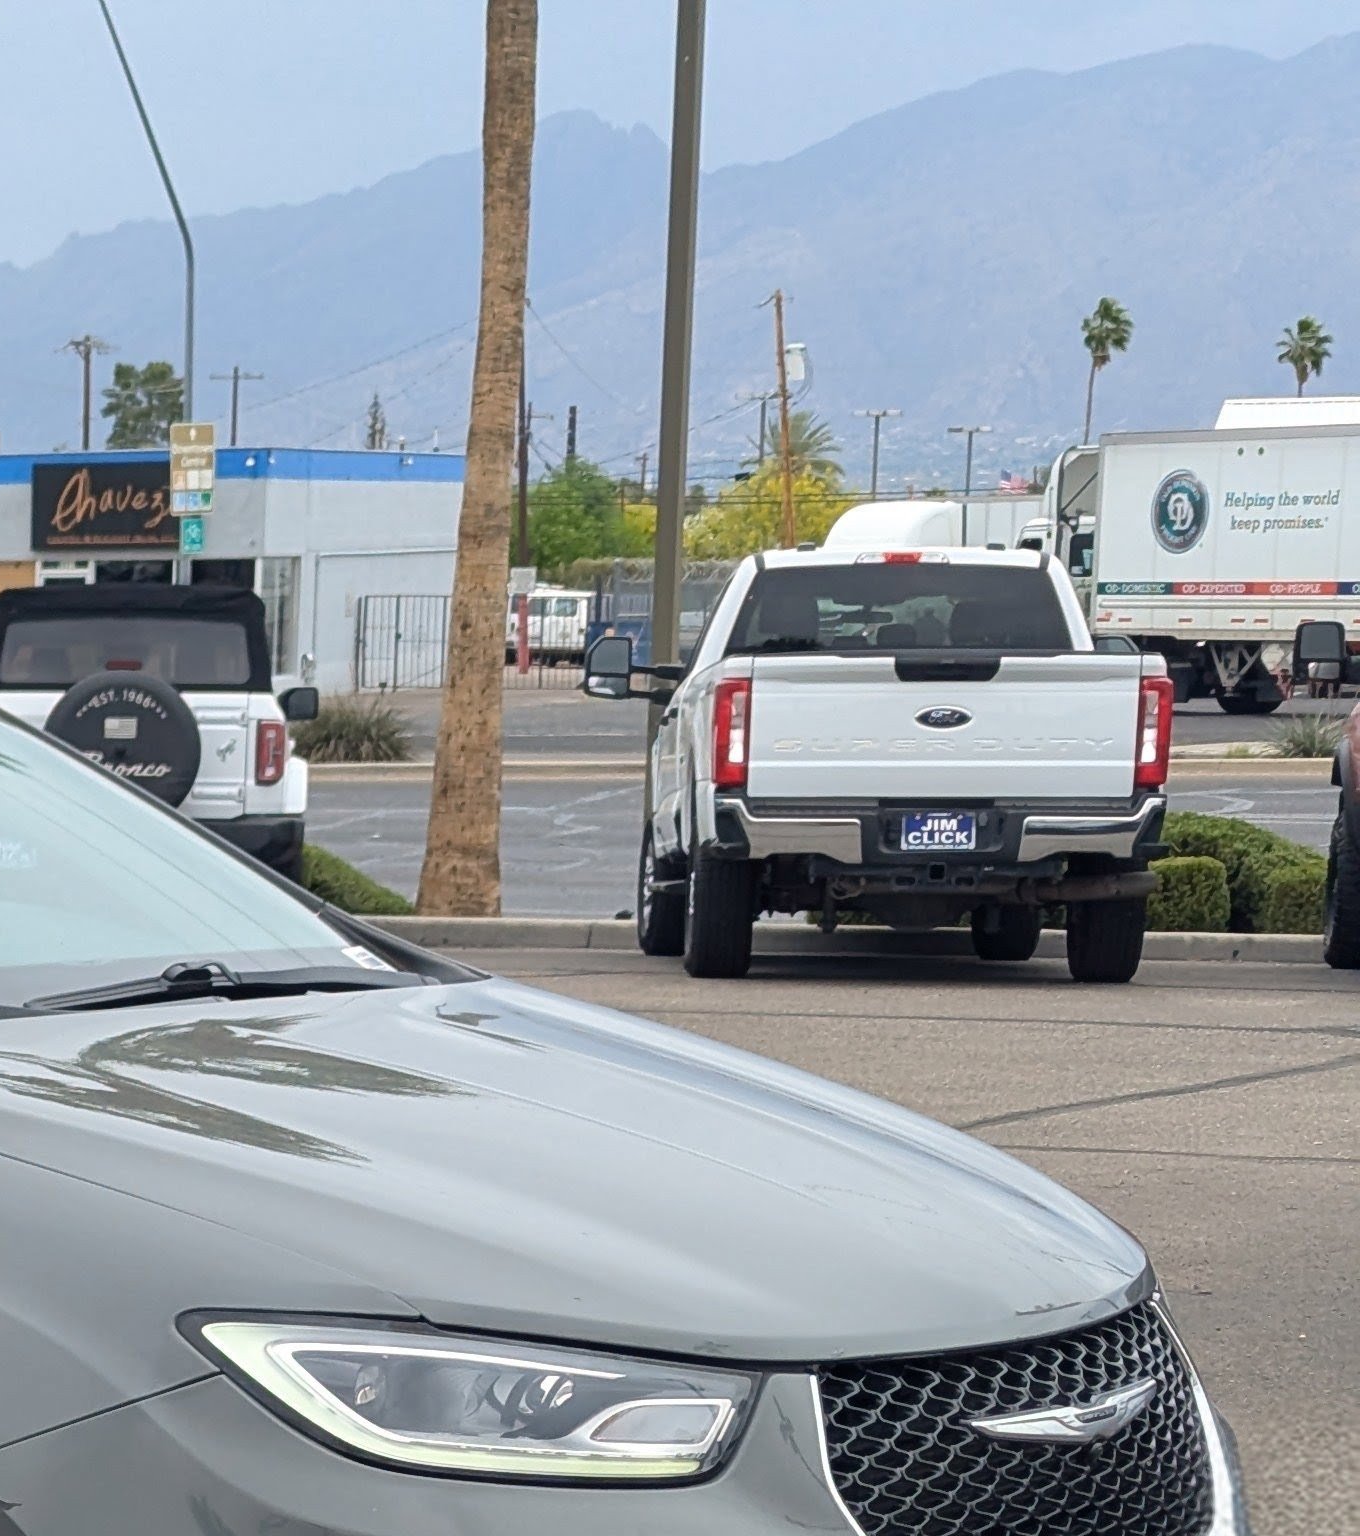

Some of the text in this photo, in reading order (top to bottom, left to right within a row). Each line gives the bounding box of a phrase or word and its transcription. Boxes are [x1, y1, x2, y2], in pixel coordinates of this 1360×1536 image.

[50, 468, 170, 532] Chavez
[1223, 488, 1341, 510] Helping the world
[1229, 514, 1261, 534] keep
[773, 738, 1115, 752] SUPER DUTY
[920, 818, 958, 831] JIM
[907, 831, 969, 844] CLICK
